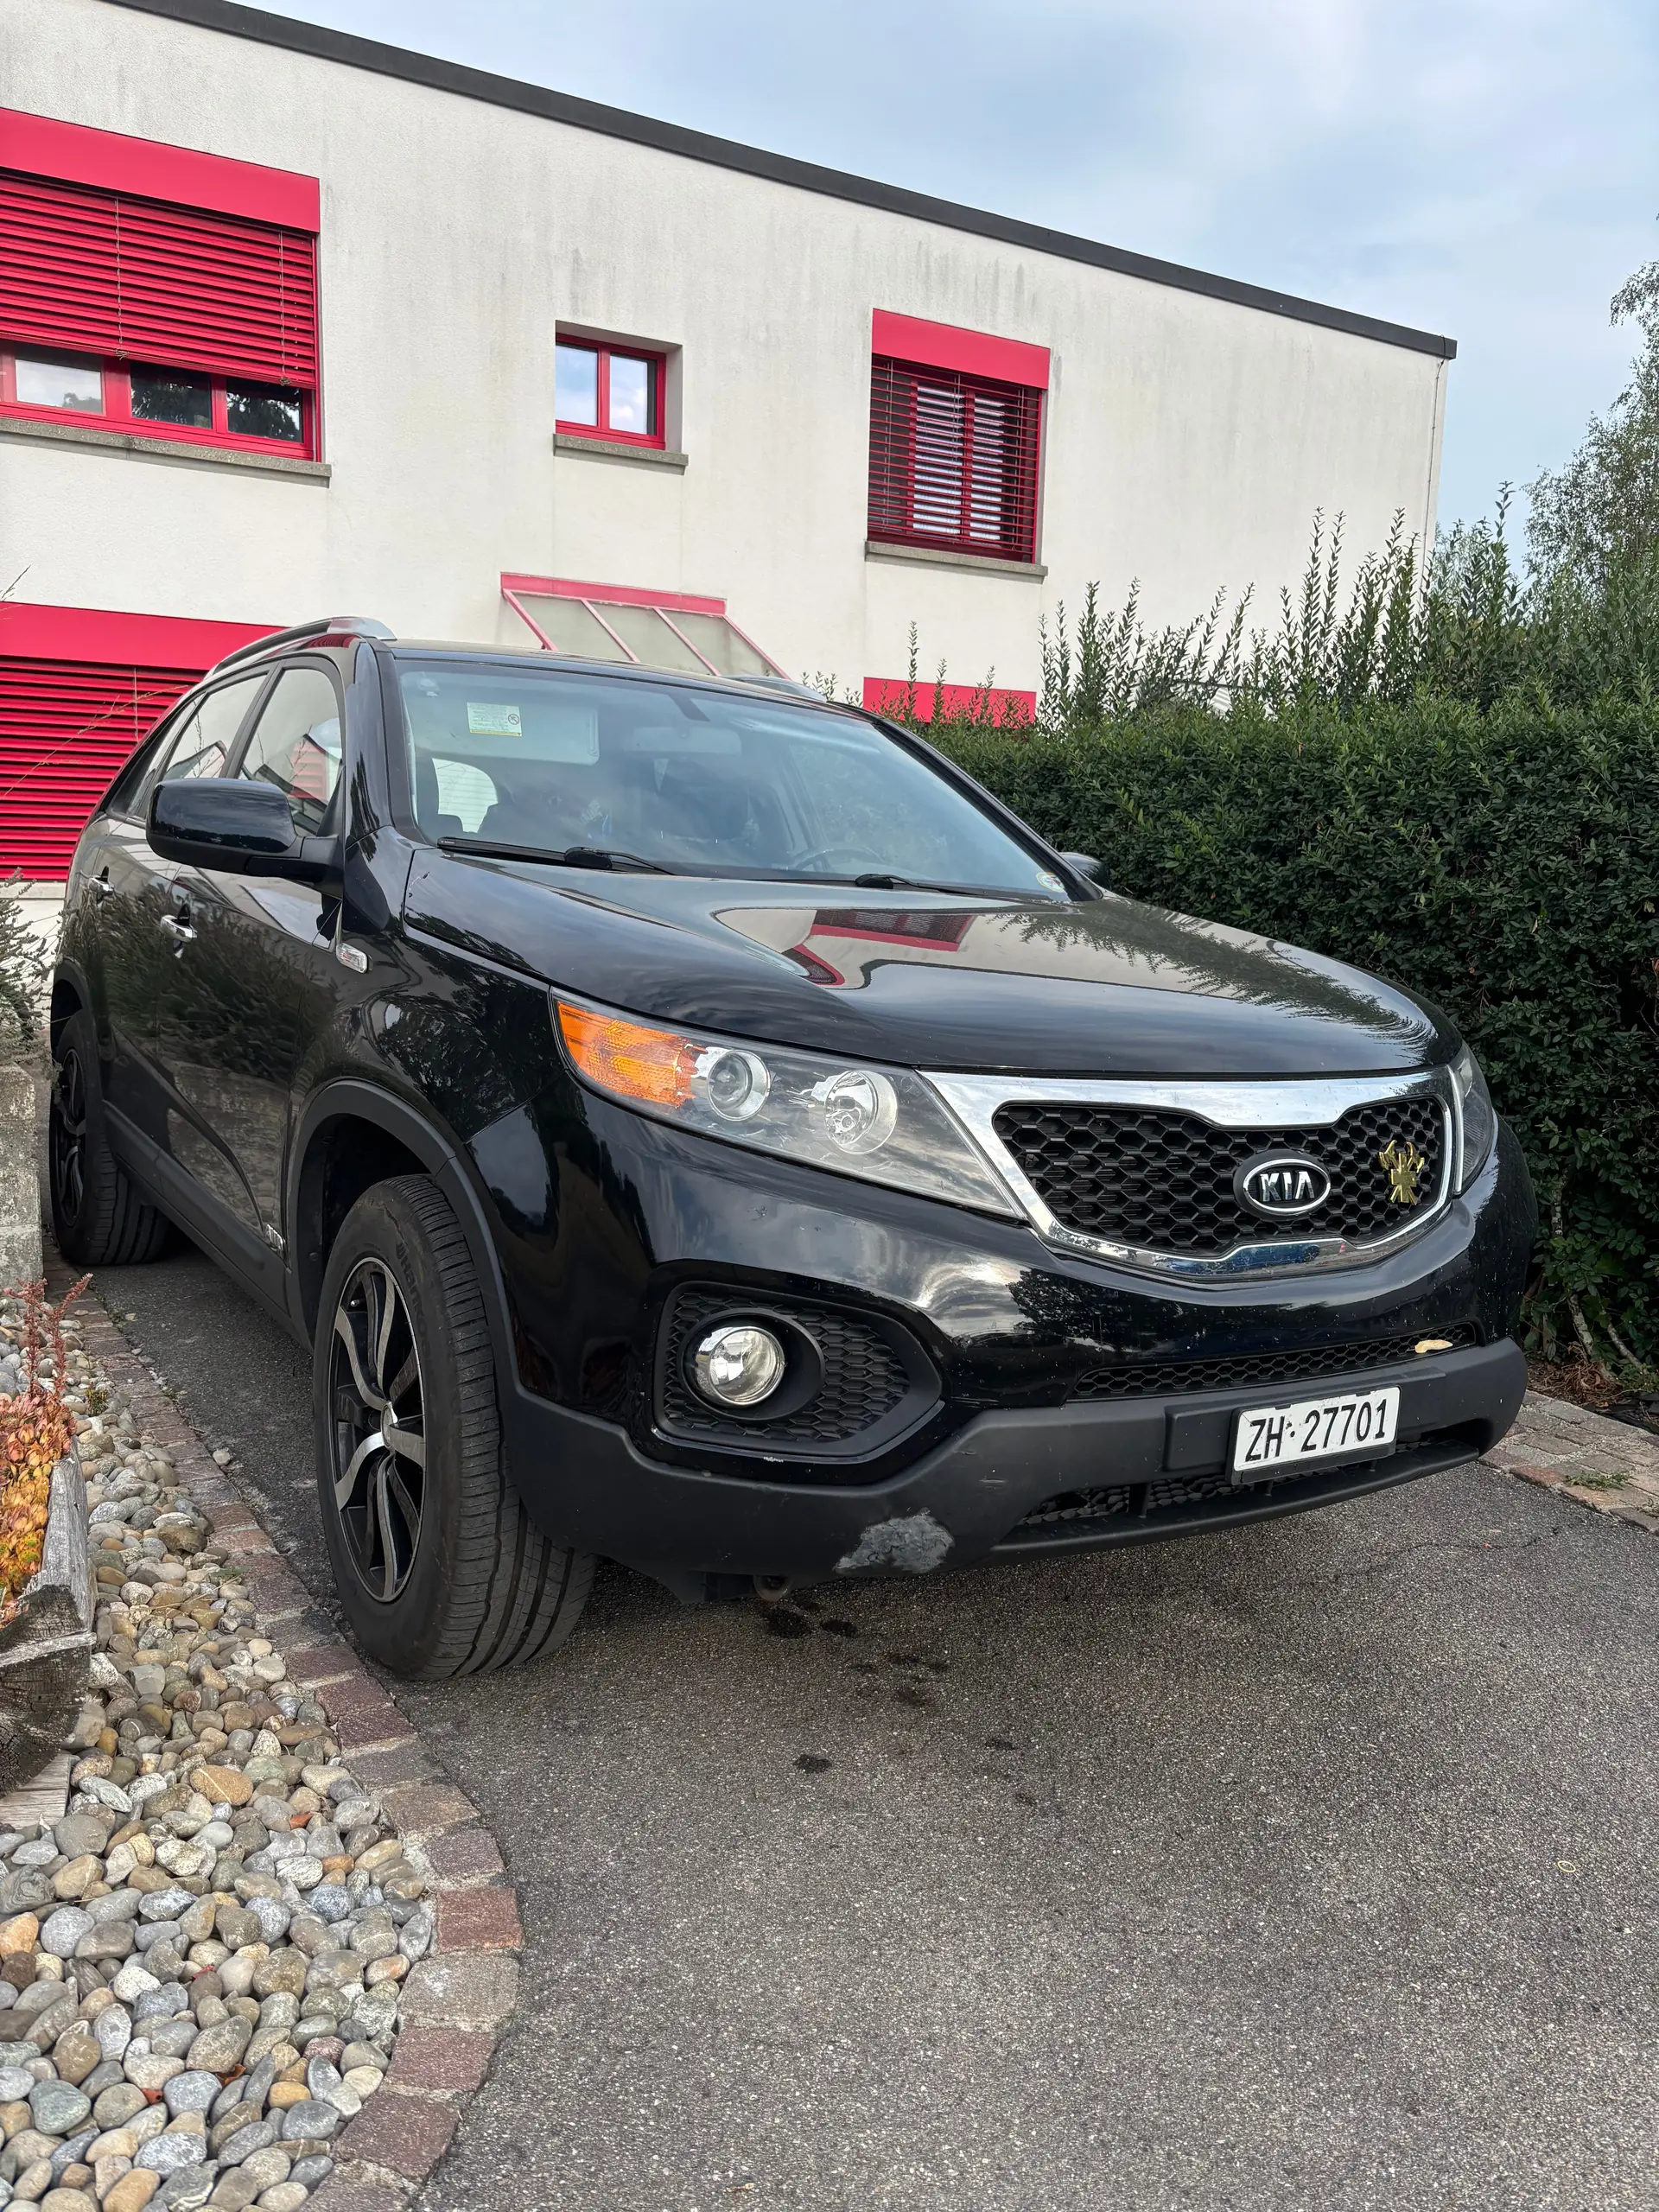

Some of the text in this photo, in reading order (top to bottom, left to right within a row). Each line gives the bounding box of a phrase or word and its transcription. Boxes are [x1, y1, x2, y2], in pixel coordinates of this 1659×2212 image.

[1259, 1171, 1316, 1202] KIA
[1244, 1398, 1387, 1462] ZH 27701
